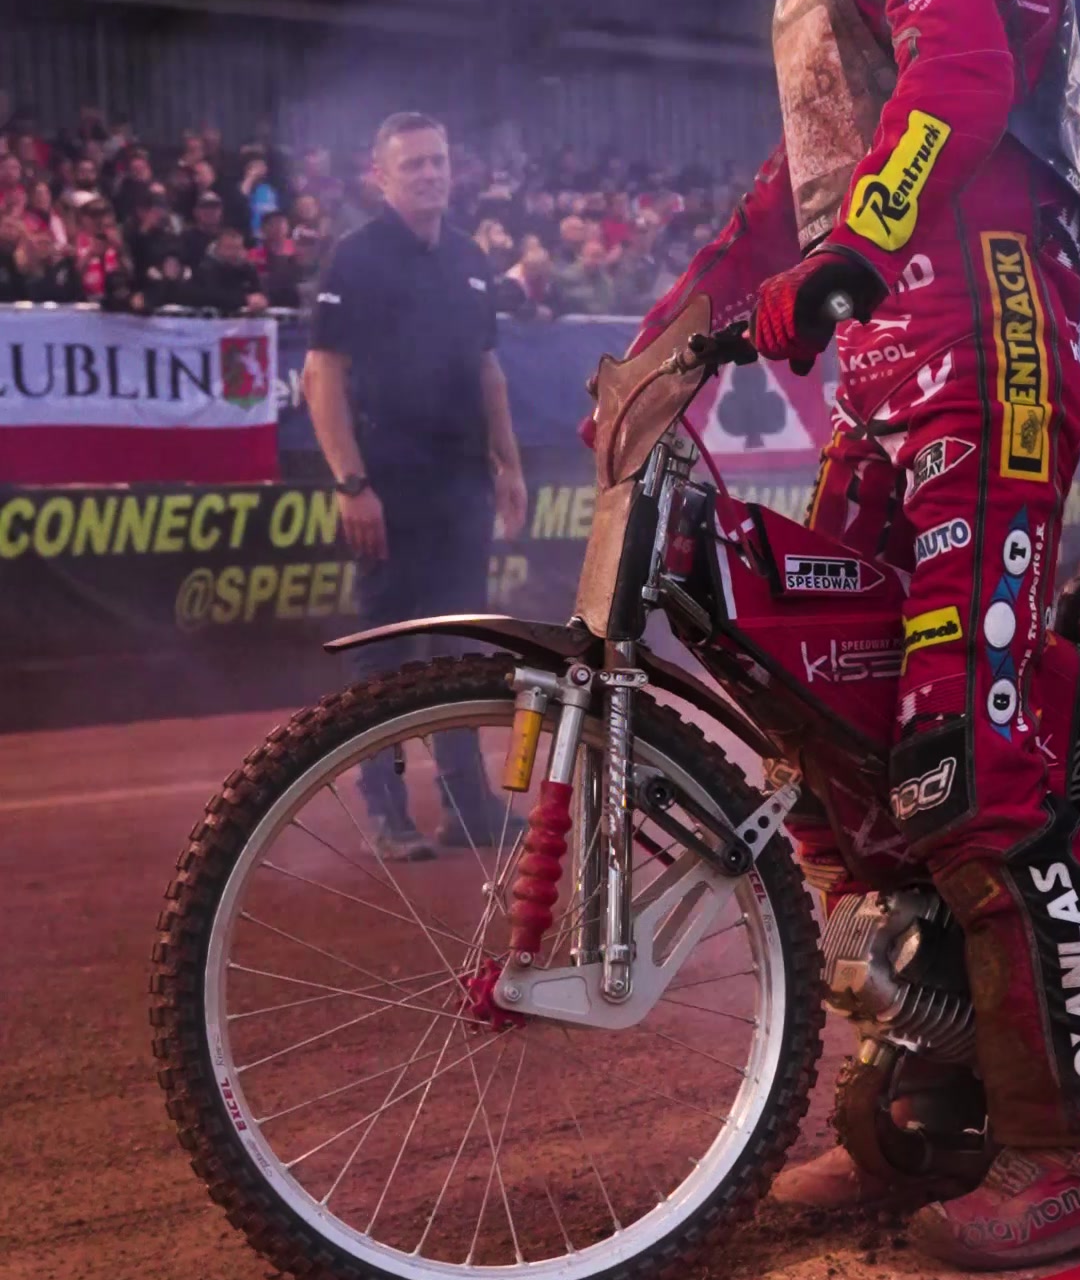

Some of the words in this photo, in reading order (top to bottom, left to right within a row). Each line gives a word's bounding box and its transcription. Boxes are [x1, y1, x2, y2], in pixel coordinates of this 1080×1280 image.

[855, 122, 941, 237] Rentruck
[996, 251, 1037, 406] ENTRACK
[0, 342, 218, 402] UBLIN
[0, 493, 260, 559] CONNECT
[269, 489, 339, 548] ON
[916, 519, 969, 560] AUTO
[787, 575, 859, 590] SPEEDWAY
[841, 640, 890, 651] SPEEDWAY
[220, 1077, 247, 1131] EXCEL
